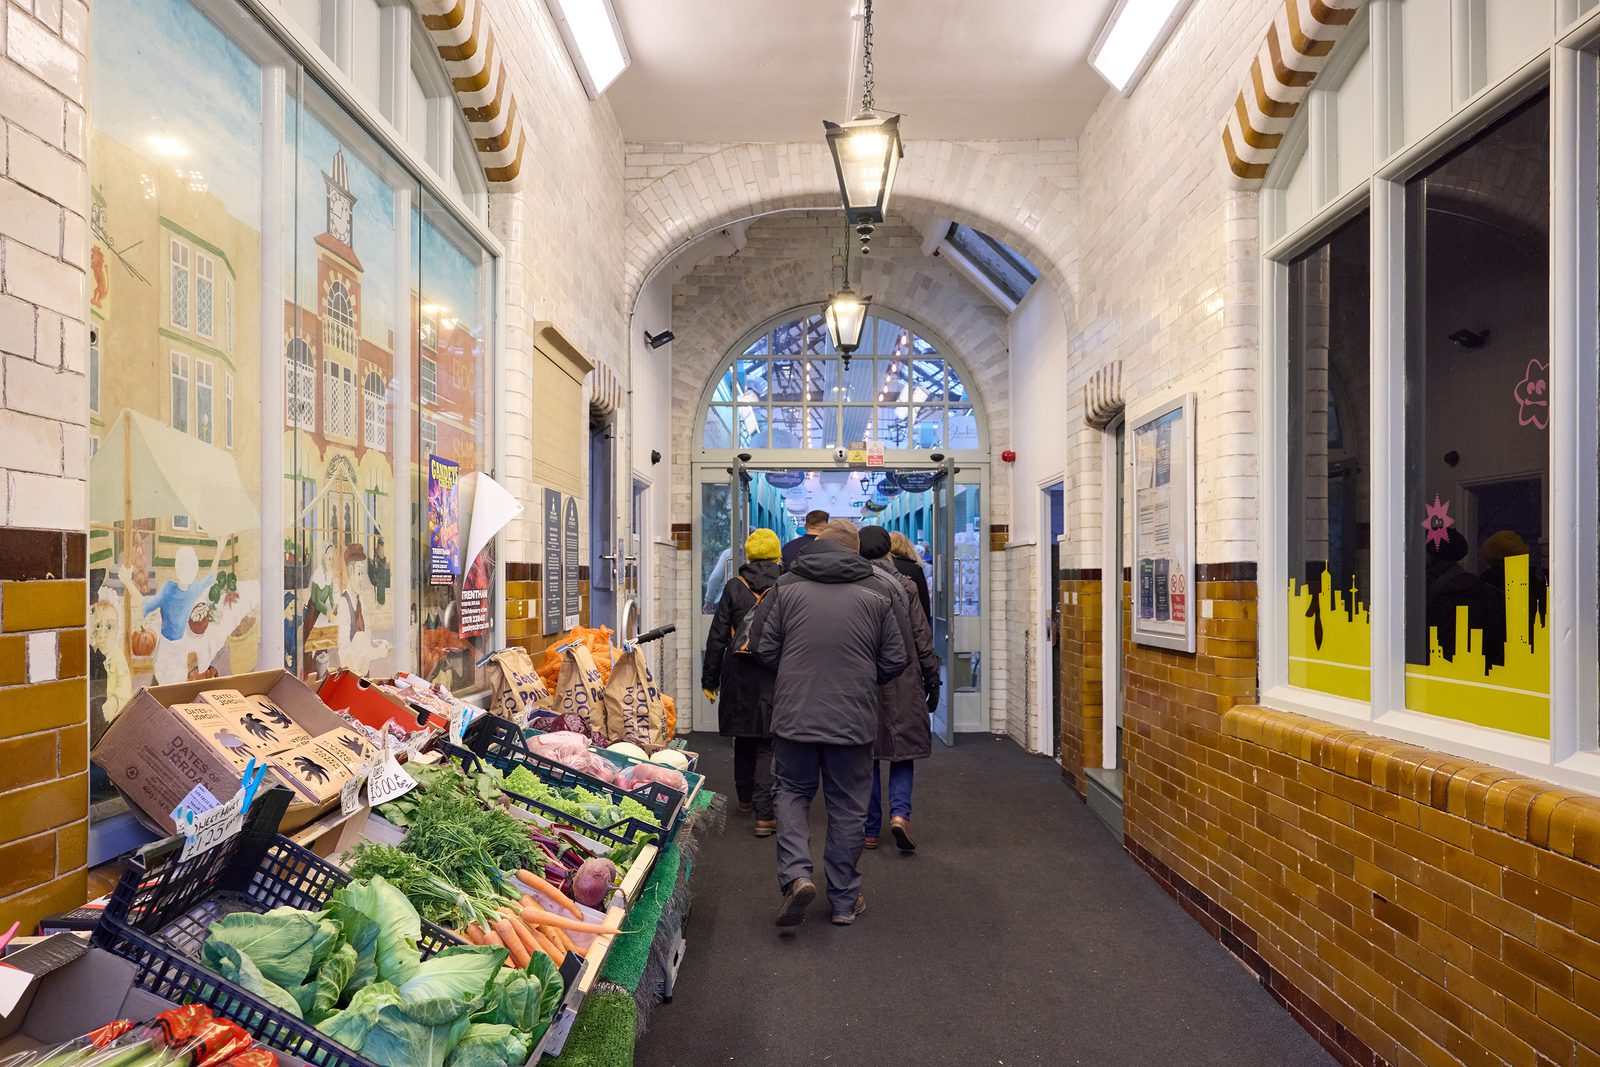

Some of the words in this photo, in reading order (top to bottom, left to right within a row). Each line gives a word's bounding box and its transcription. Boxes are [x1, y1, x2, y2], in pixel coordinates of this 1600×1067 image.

[212, 693, 233, 701] DATES
[171, 735, 209, 774] DATES
[208, 773, 222, 784] OF
